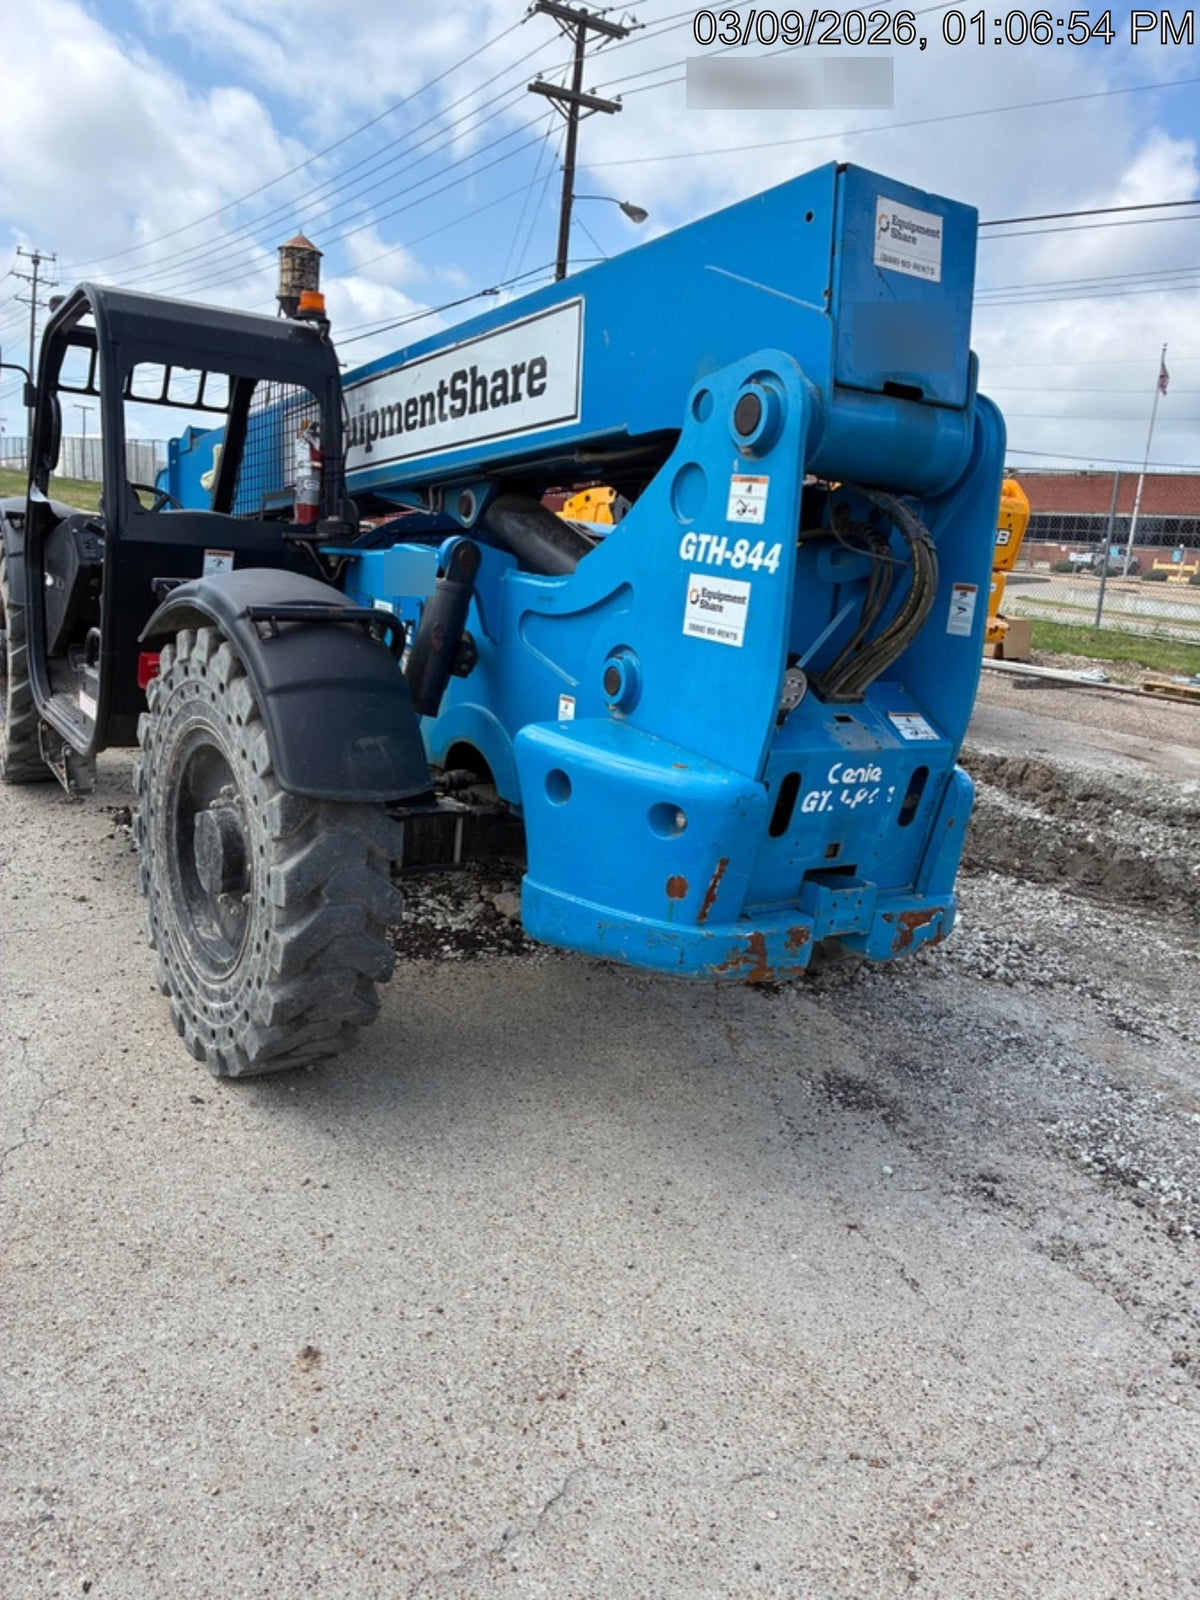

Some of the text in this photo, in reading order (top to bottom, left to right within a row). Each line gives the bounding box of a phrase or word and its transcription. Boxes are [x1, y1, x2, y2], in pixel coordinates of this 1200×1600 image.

[890, 227, 918, 245] Share
[892, 214, 941, 239] Equipment
[345, 355, 548, 454] uipmentShare
[679, 531, 782, 574] GTH-844
[700, 598, 724, 613] Share
[702, 587, 747, 605] Equipment
